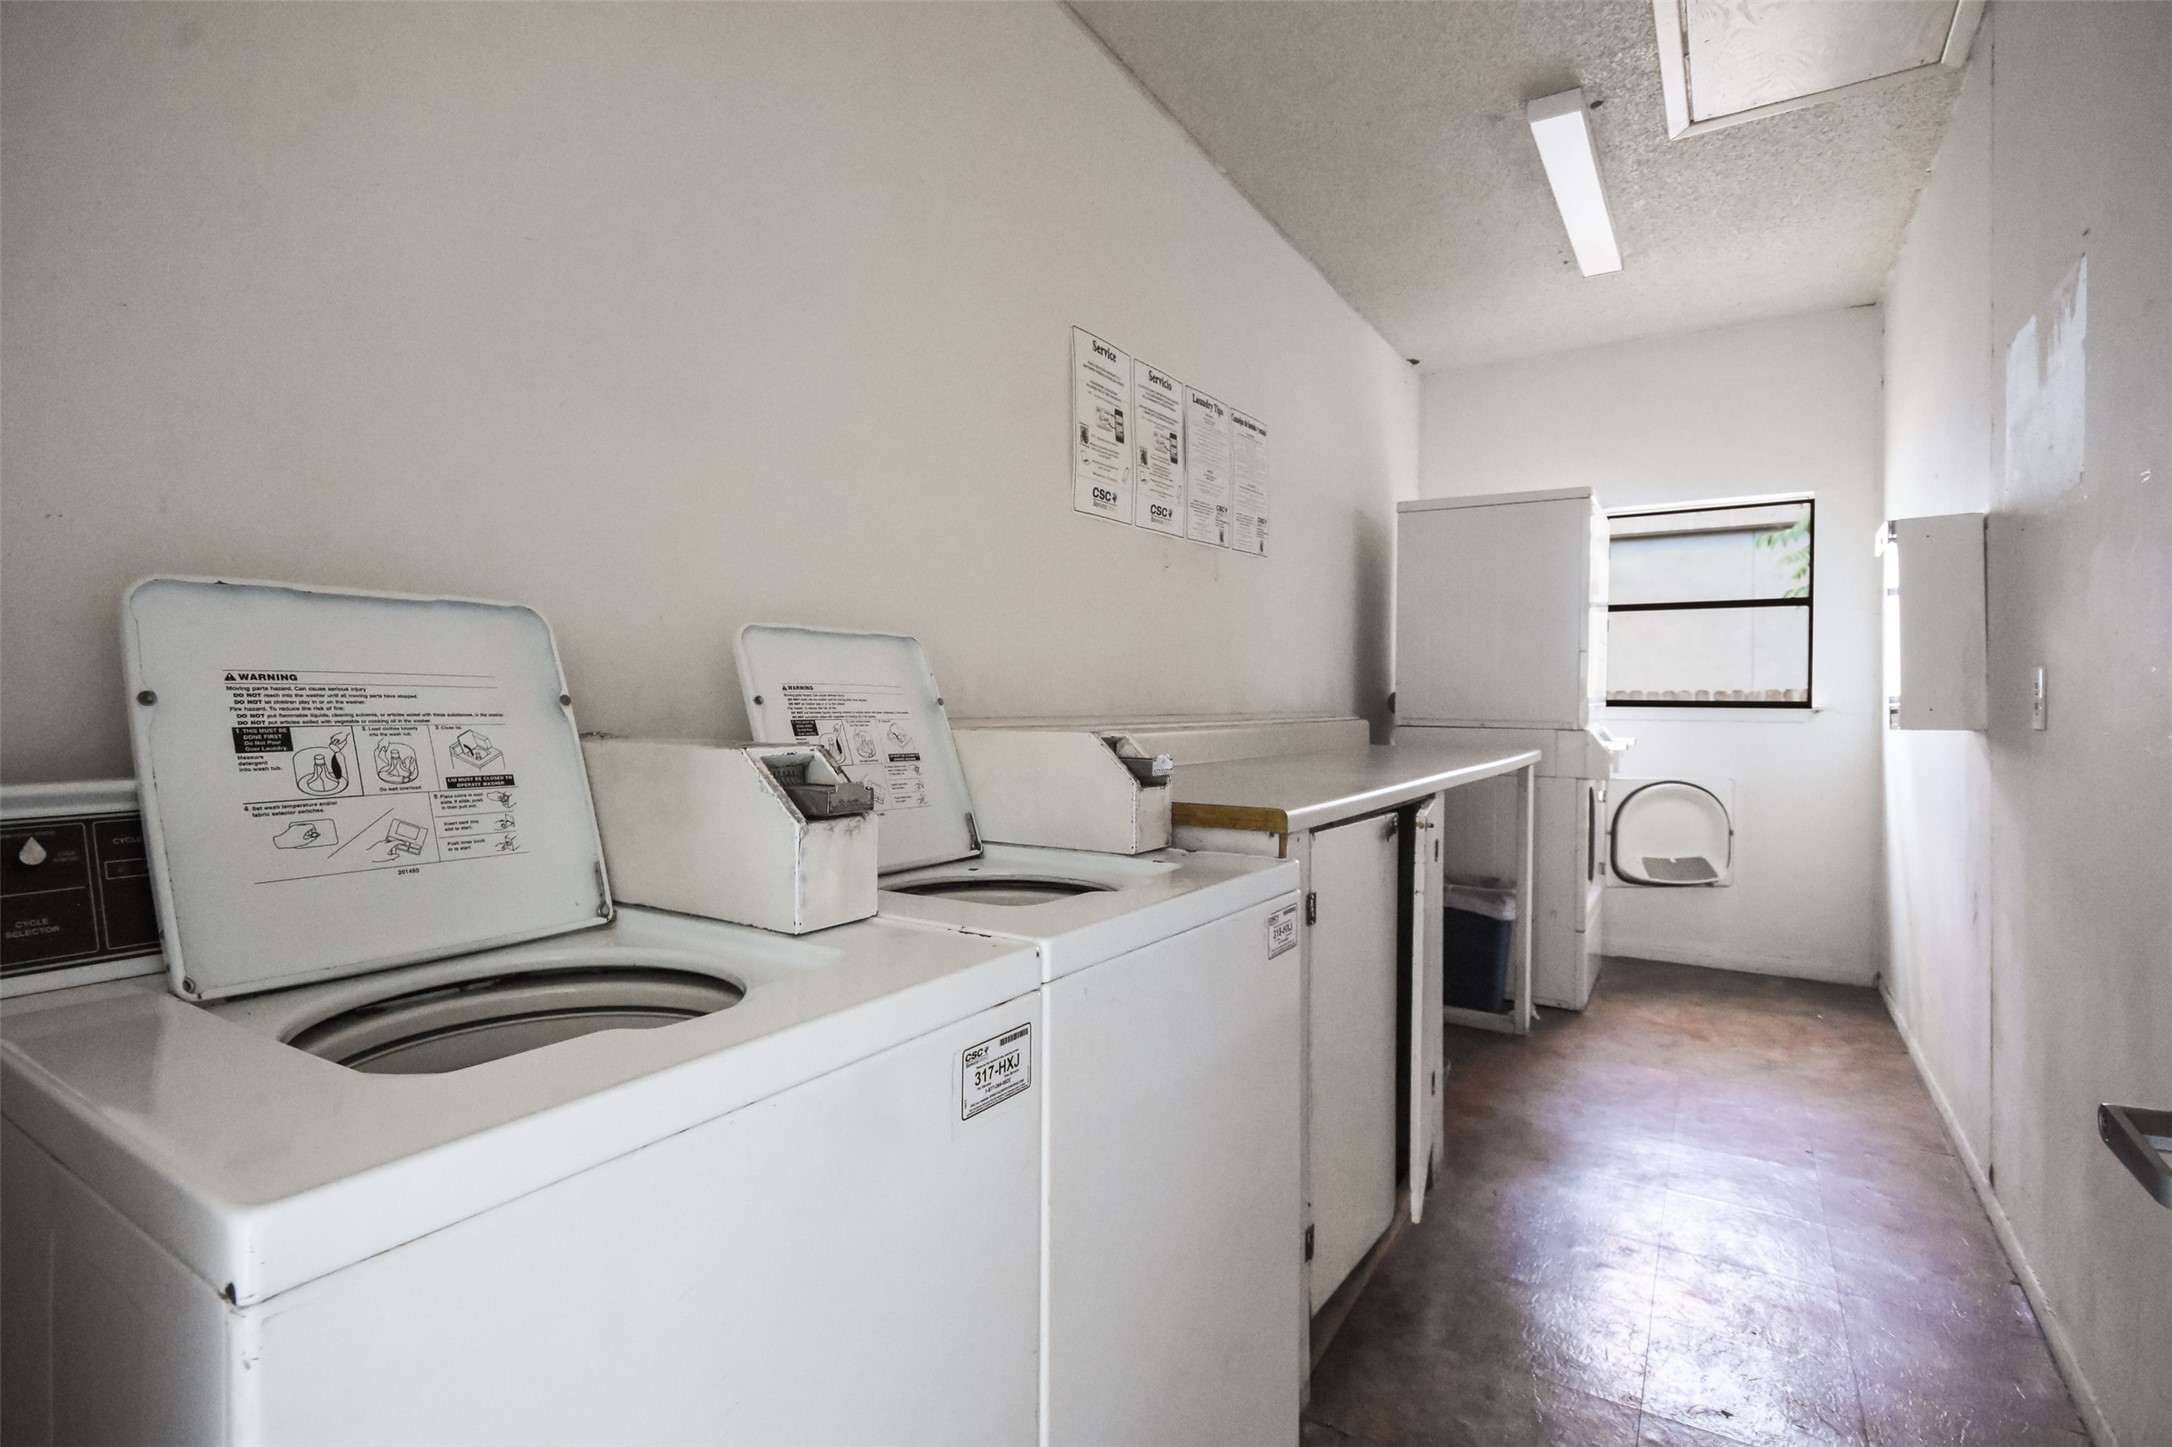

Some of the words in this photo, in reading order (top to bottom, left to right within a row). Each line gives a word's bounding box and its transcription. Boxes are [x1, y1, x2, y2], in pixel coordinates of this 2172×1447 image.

[1092, 340, 1117, 363] Service
[1148, 370, 1172, 391] Servicio
[1192, 393, 1213, 413] Laundry
[1093, 487, 1112, 502] CSC
[1149, 504, 1168, 517] CSC
[238, 673, 298, 681] WARNING
[281, 802, 318, 810] temperature
[15, 918, 49, 929] CYCLE
[5, 925, 61, 939] SELECTOR
[965, 1048, 984, 1063] CSC
[974, 1053, 1020, 1086] 317-HXJ
